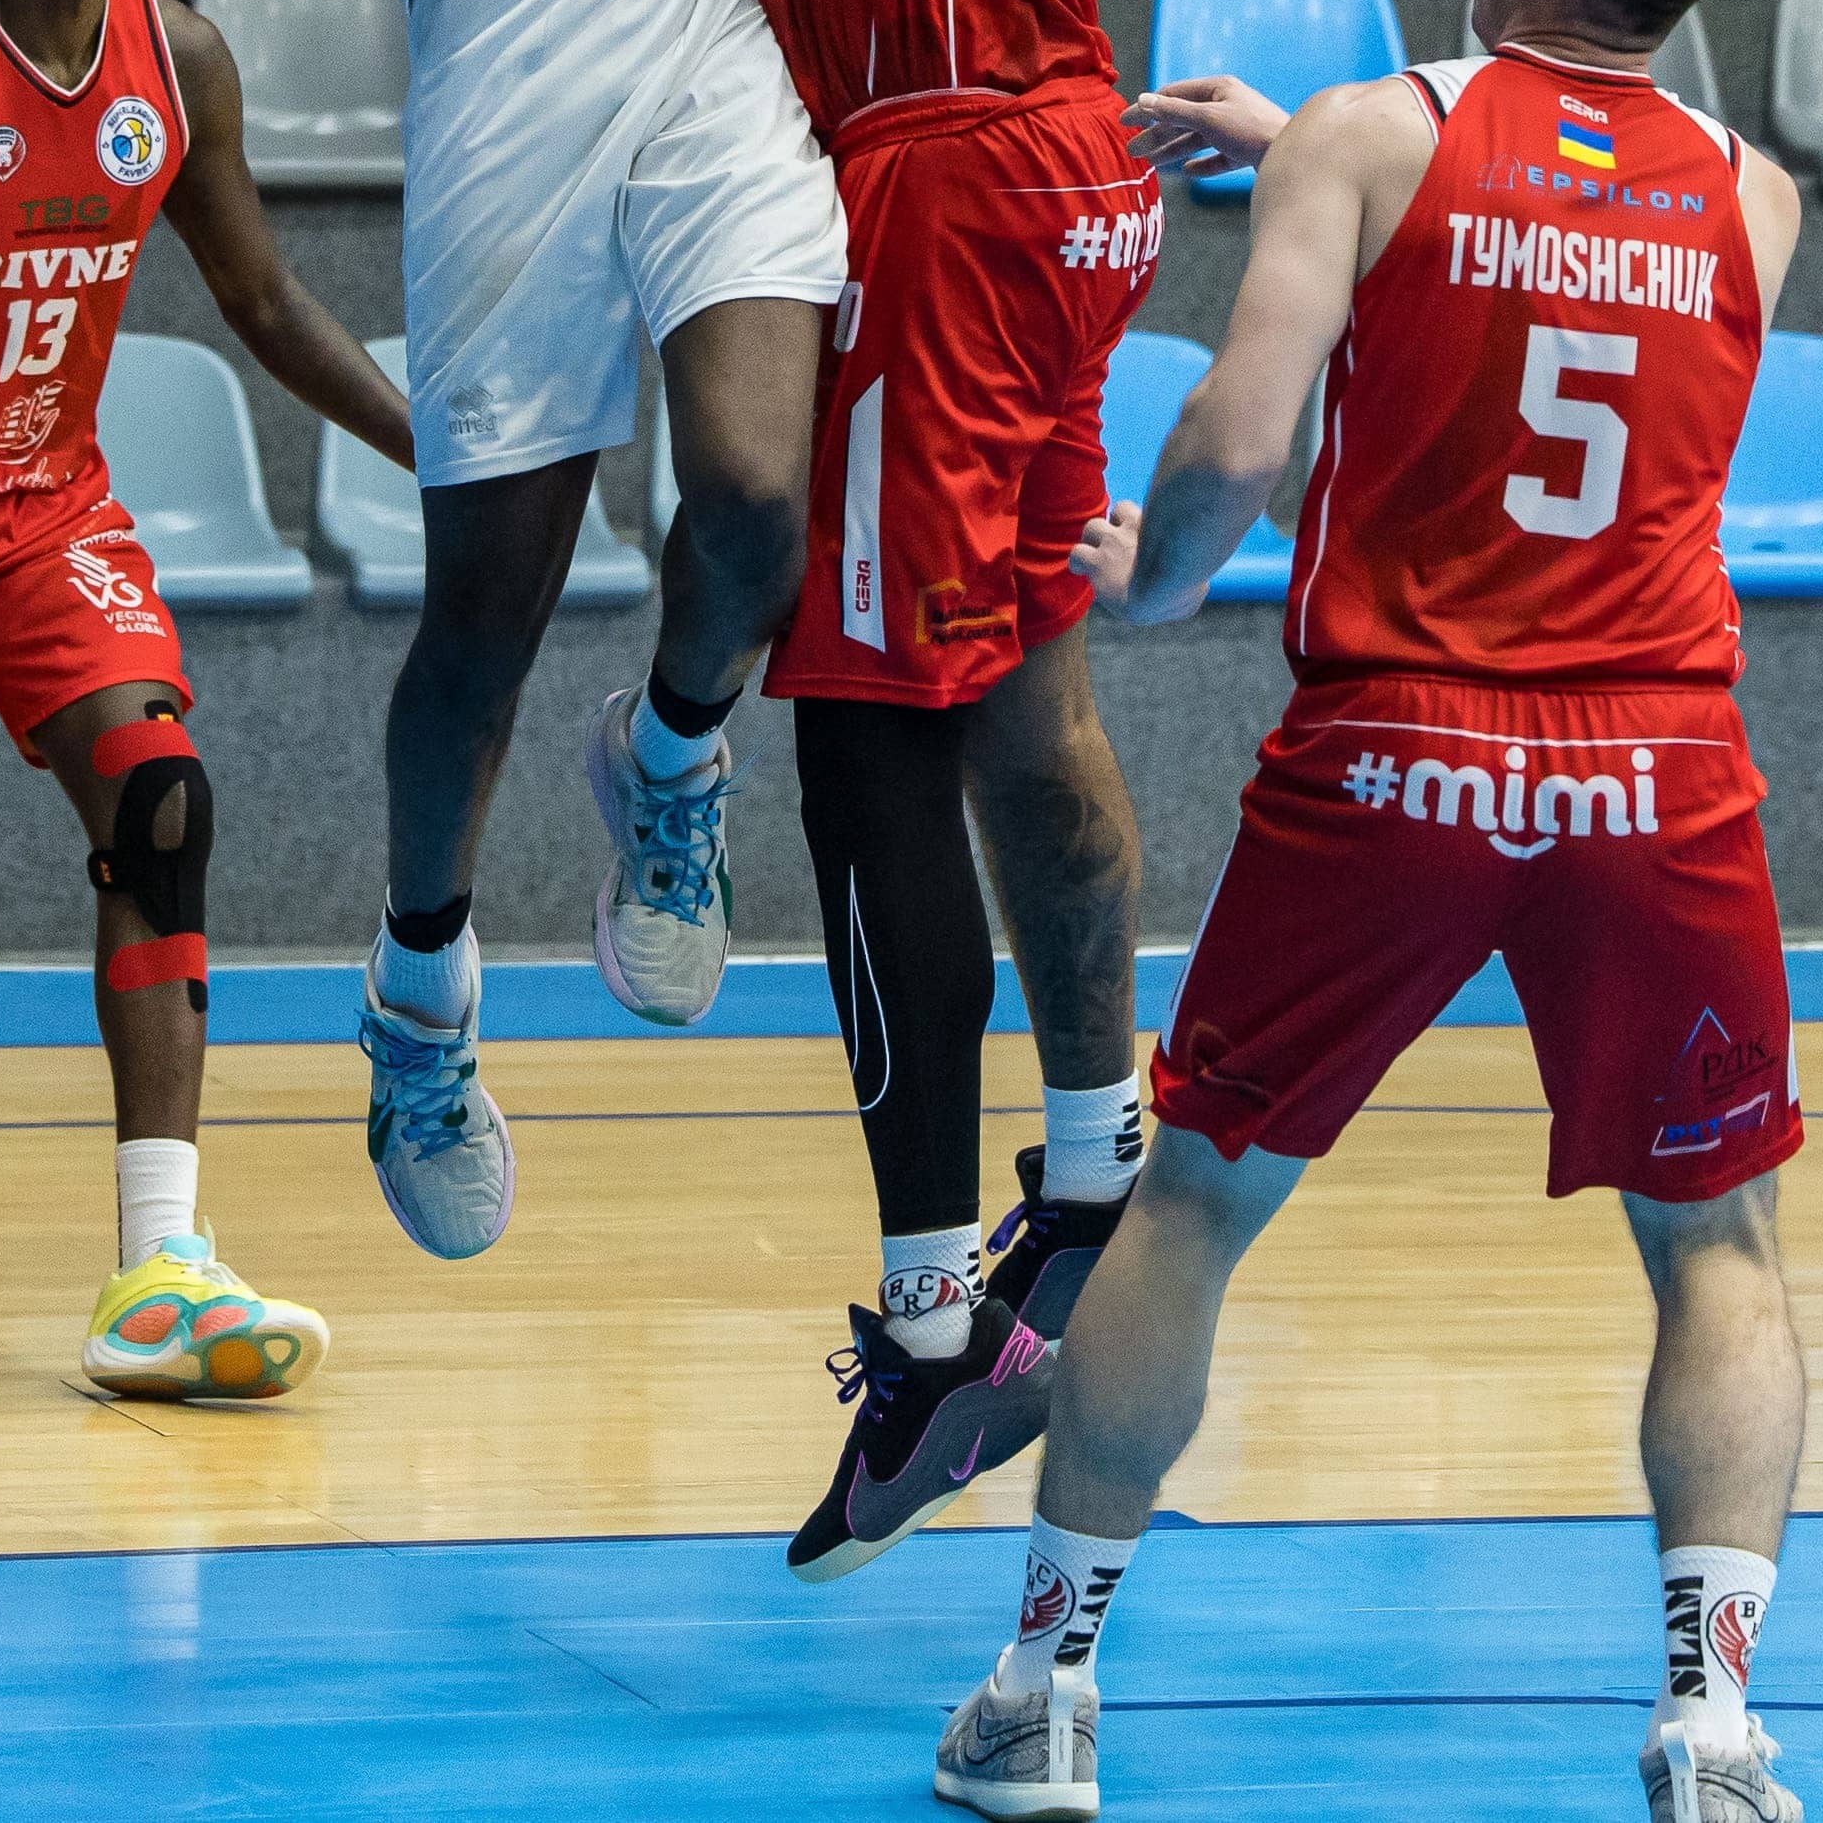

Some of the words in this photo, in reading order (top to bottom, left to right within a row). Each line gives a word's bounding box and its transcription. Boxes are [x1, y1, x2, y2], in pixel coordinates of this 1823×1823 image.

[1559, 94, 1609, 124] GERA
[19, 194, 110, 230] TBG
[1528, 164, 1705, 215] EPSILON
[1059, 190, 1165, 270] #mim
[1447, 212, 1719, 323] TYMOSHCHUK
[1503, 324, 1641, 540] 5
[104, 610, 159, 625] VECTOR
[114, 622, 168, 638] GLOBAL
[1342, 744, 1661, 840] #mimi
[1664, 1576, 1707, 1700] SLAM
